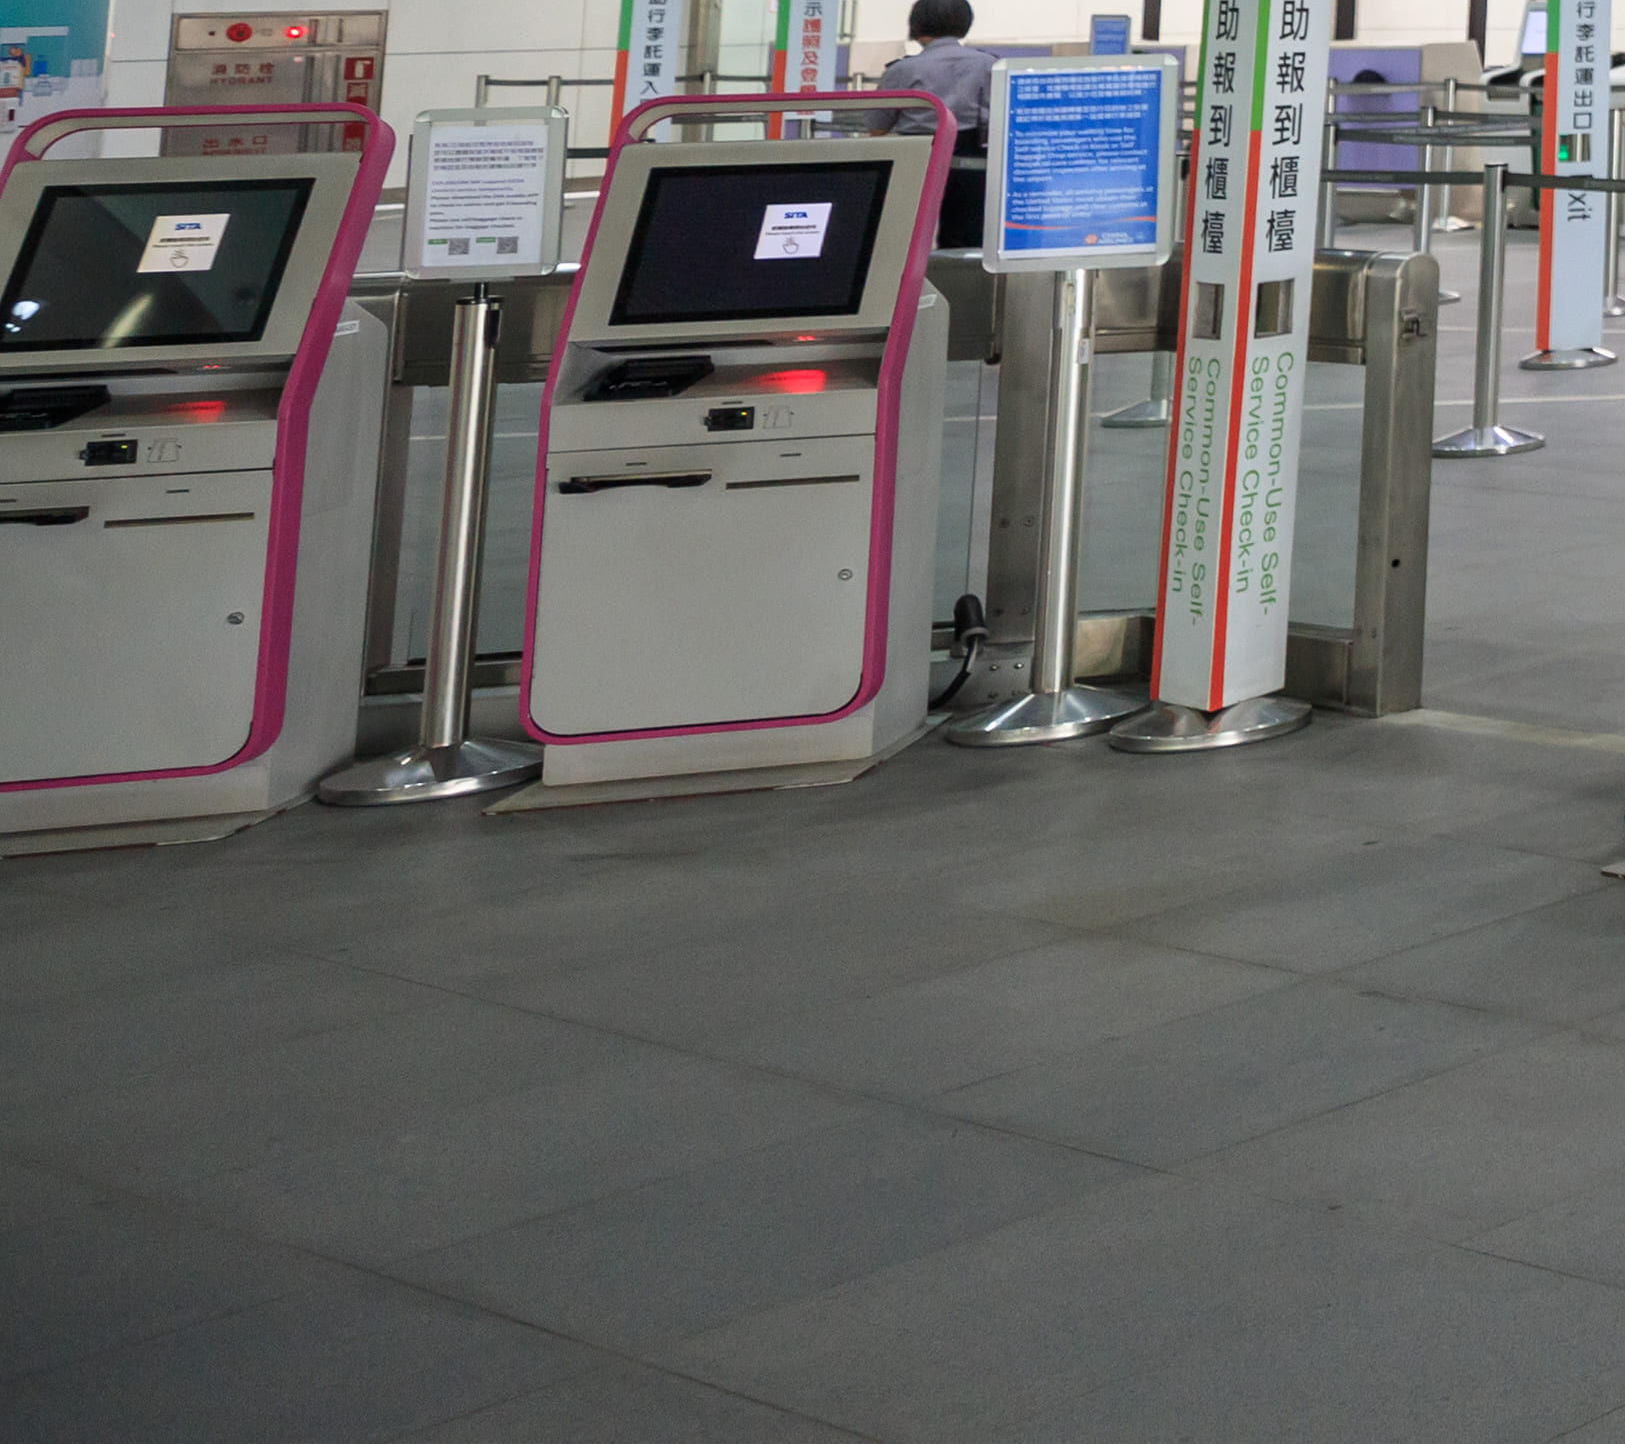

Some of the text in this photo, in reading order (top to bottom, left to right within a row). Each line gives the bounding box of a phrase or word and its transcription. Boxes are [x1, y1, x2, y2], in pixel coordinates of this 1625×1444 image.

[1172, 356, 1203, 593] Service Check-in
[1189, 357, 1222, 627] Common-Use Self-
[1236, 355, 1270, 594] Service Check-in
[1259, 351, 1294, 616] Common-Use Self-
